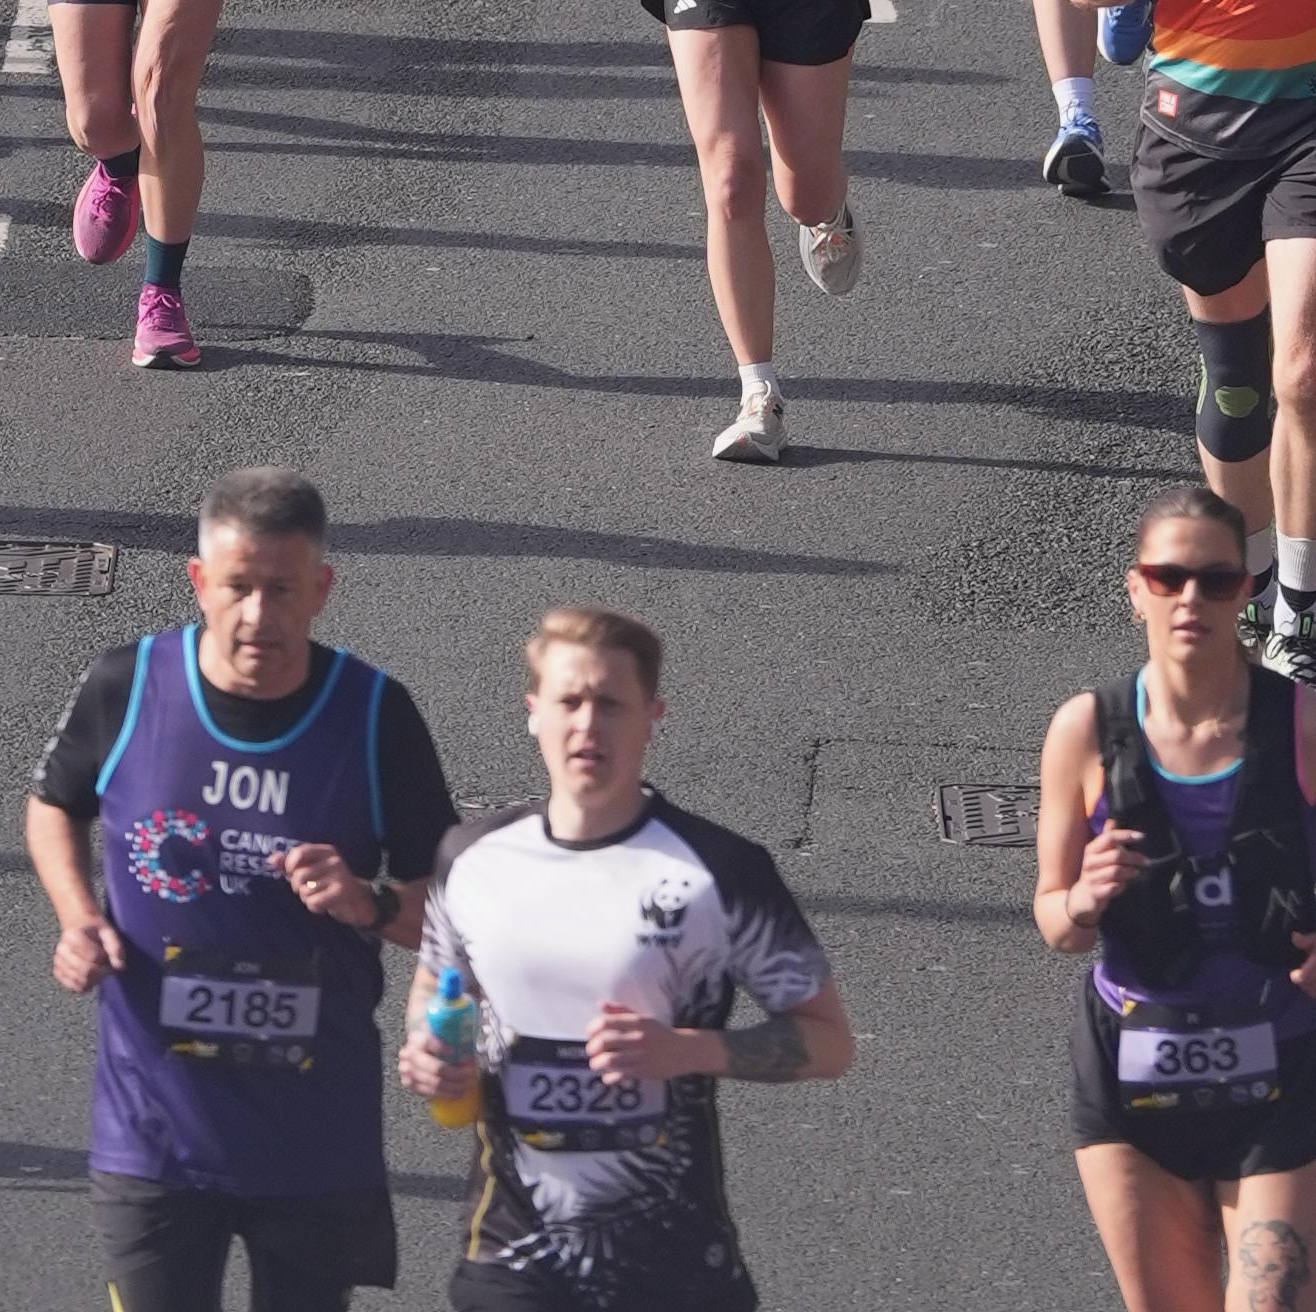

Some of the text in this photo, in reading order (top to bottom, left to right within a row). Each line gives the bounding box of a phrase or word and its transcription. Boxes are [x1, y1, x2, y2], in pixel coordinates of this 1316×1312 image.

[202, 760, 290, 815] JON
[220, 874, 251, 895] UK
[187, 985, 298, 1030] 2185
[1155, 1036, 1239, 1075] 363
[529, 1073, 642, 1114] 2328
